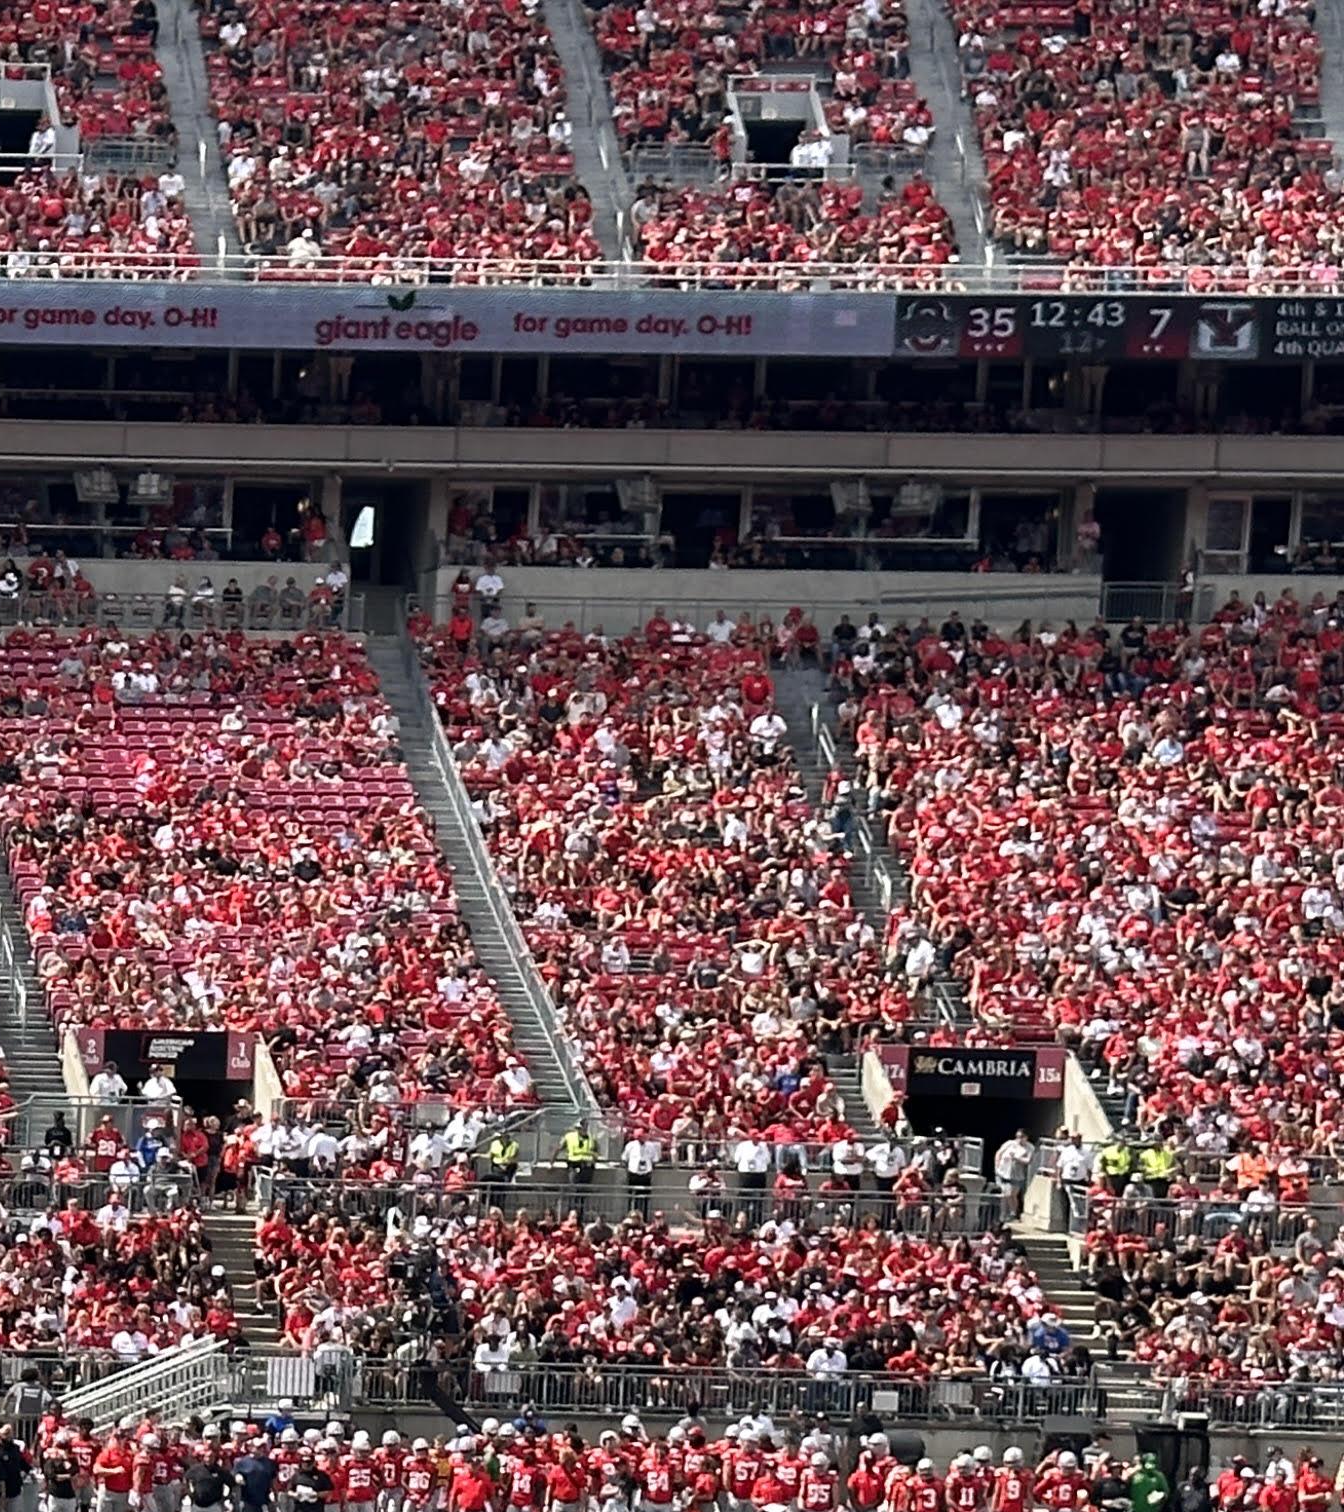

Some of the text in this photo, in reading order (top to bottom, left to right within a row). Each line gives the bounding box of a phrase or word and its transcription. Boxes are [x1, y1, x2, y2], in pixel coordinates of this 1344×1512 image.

[24, 305, 96, 330] game
[103, 305, 155, 332] day.
[163, 306, 217, 328] O-H!
[968, 306, 1016, 338] 35
[1030, 300, 1126, 328] 12:43
[1149, 307, 1173, 340] 7
[1276, 303, 1306, 317] 4th
[315, 312, 479, 348] giant eagle
[513, 309, 752, 340] for game day. O-H!
[1274, 342, 1304, 355] 4th
[937, 1057, 1031, 1077] CAMBRIA
